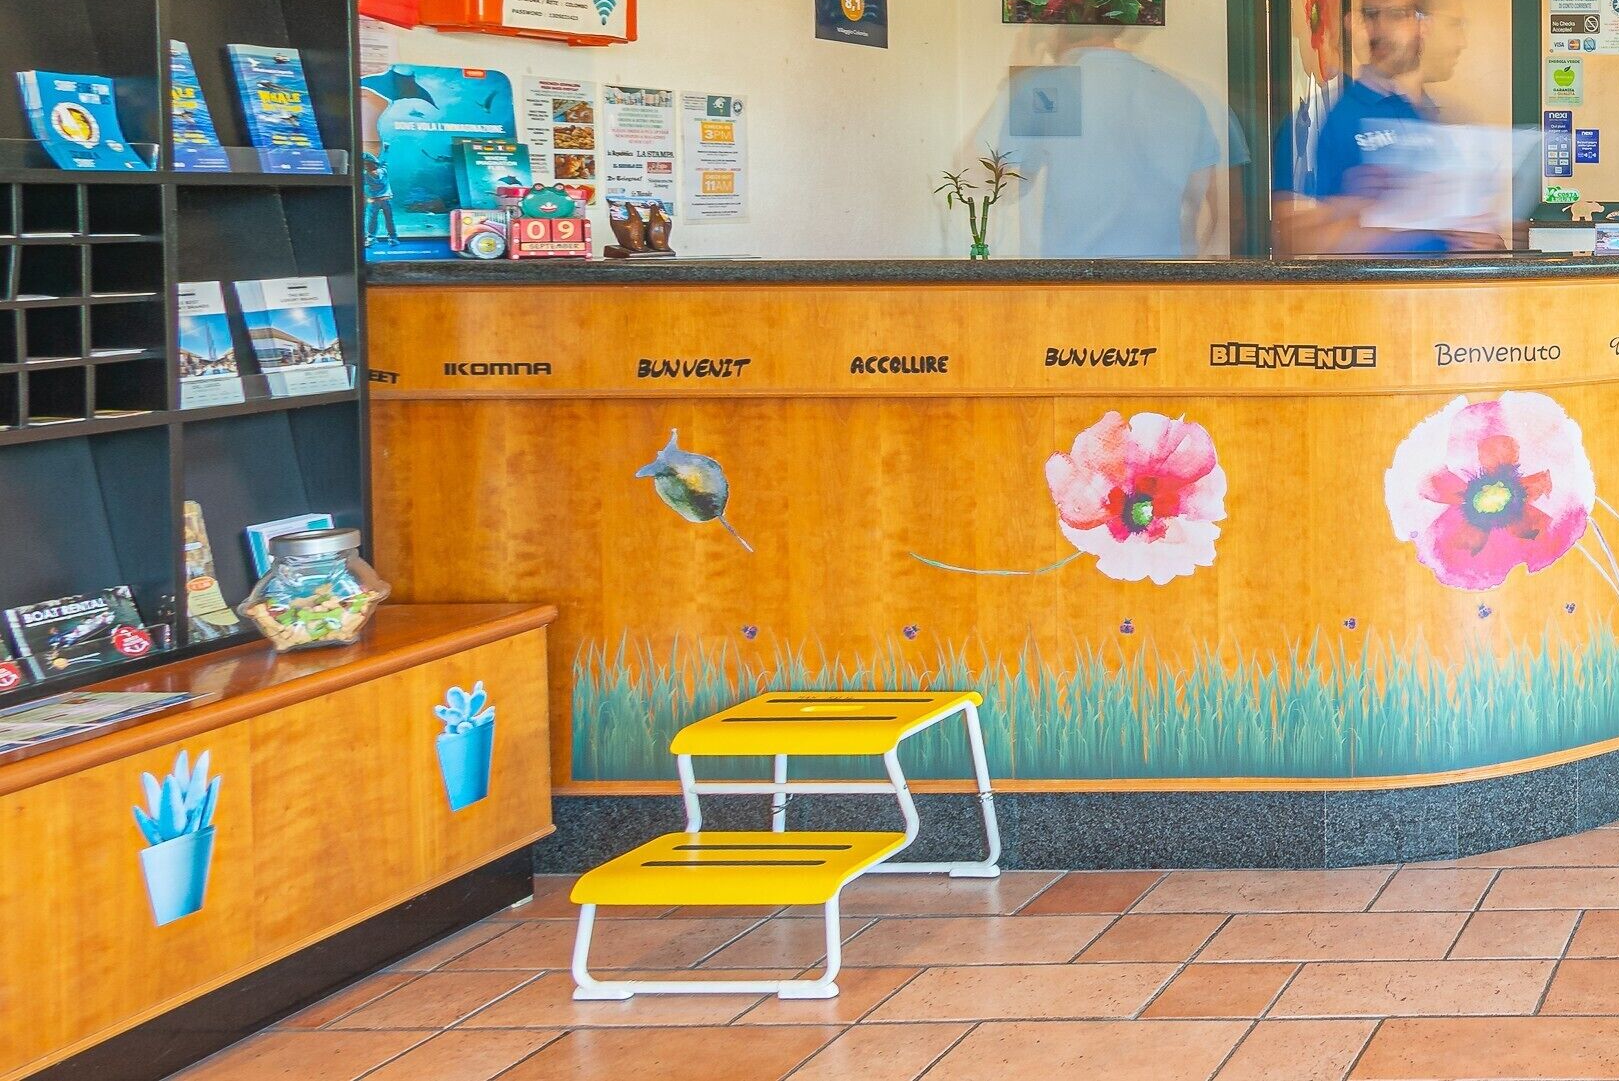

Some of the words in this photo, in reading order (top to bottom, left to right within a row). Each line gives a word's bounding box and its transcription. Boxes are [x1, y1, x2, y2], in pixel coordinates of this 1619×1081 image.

[850, 355, 950, 374] ACCOLLIRE
[1434, 342, 1561, 367] Benvenuto
[23, 606, 62, 623] BOAT
[63, 597, 108, 616] RENTAL
